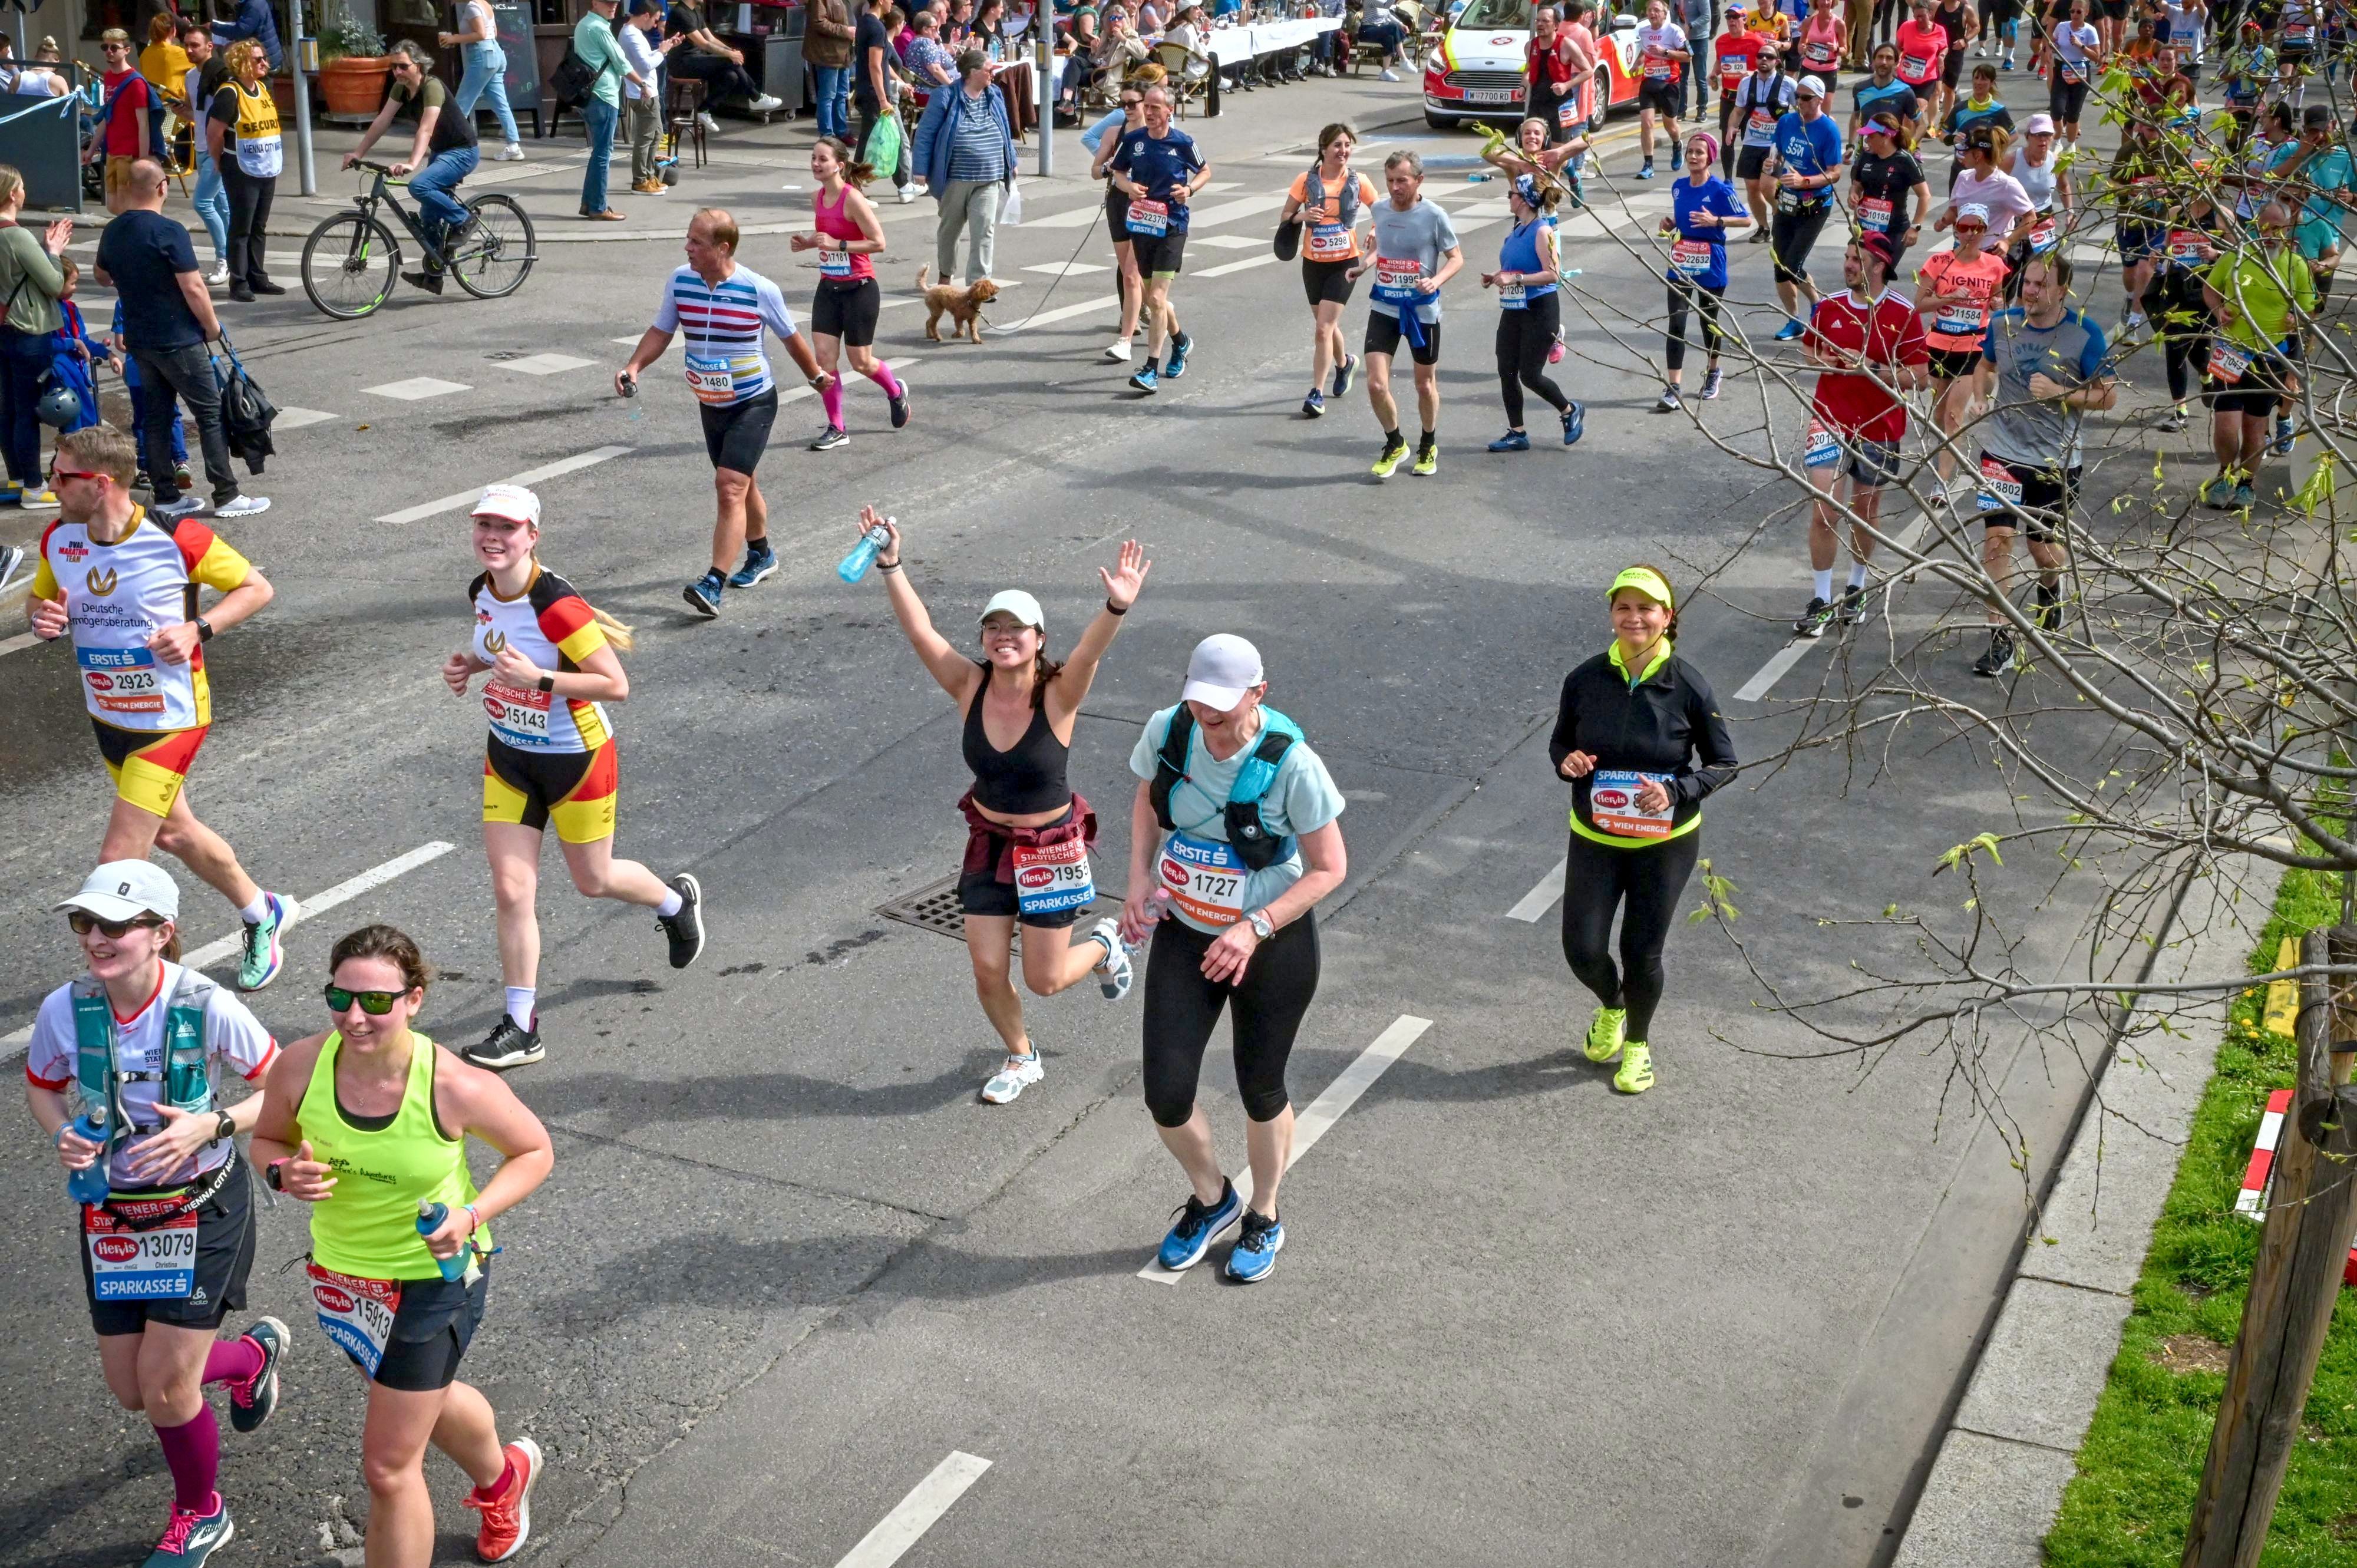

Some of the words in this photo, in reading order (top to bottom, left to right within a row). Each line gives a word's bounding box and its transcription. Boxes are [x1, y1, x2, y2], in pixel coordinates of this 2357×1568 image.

[1480, 92, 1498, 100] 7700
[243, 144, 264, 153] VIENNA
[265, 143, 274, 153] CITY
[1144, 213, 1166, 225] 22370
[1869, 212, 1890, 221] 10184
[1133, 225, 1151, 233] ERSTE
[1313, 225, 1341, 233] SPARKASSE
[1329, 236, 1347, 247] 5298
[828, 253, 847, 262] 17181
[1686, 255, 1709, 263] 22632
[1951, 276, 1992, 289] IGNITE
[1384, 289, 1404, 298] ERSTE
[1504, 285, 1524, 295] 11203
[1955, 308, 1982, 320] 11584
[1942, 323, 1962, 332] ERSTE
[686, 355, 718, 371] SPARKASSE
[704, 377, 728, 387] 1480
[1804, 449, 1834, 465] SPARKASSE
[1991, 481, 2021, 496] 18802
[1977, 499, 1998, 510] ERSTE
[58, 547, 90, 556] MARATHON
[82, 602, 123, 615] Deutsche
[70, 615, 153, 629] rmögensberatung
[89, 653, 122, 665] ERSTE
[88, 674, 112, 688] Hervis
[116, 673, 154, 689] 2923
[484, 699, 505, 716] Hervis
[506, 707, 546, 729] 15143
[1598, 771, 1662, 783] SPARKASSE
[1597, 793, 1626, 805] Hervis
[1613, 821, 1635, 830] WIEN
[1635, 823, 1668, 833] ENERGIE
[1037, 842, 1074, 855] WIENER
[1173, 840, 1211, 863] ERSTE
[1021, 849, 1076, 862] STÄDTISCHE
[1022, 871, 1052, 884] Hervis
[1055, 861, 1089, 882] 1955
[1163, 860, 1187, 883] Hervis
[1194, 873, 1238, 897] 1727
[1024, 892, 1090, 912] SPARKASSE
[1176, 897, 1195, 913] WIEN
[1197, 907, 1236, 923] ENERGIE
[180, 1186, 216, 1214] VIENNA
[214, 1172, 227, 1189] CITY
[118, 1203, 159, 1216] IENER
[98, 1240, 136, 1256] Hervis
[138, 1233, 193, 1258] 13079
[155, 1261, 178, 1269] Christina
[326, 1269, 368, 1289] WIENER
[101, 1277, 174, 1295] SPARKASSE
[316, 1288, 352, 1309] Hervis
[355, 1296, 391, 1339] 15913
[320, 1320, 372, 1365] SPARKASSE
